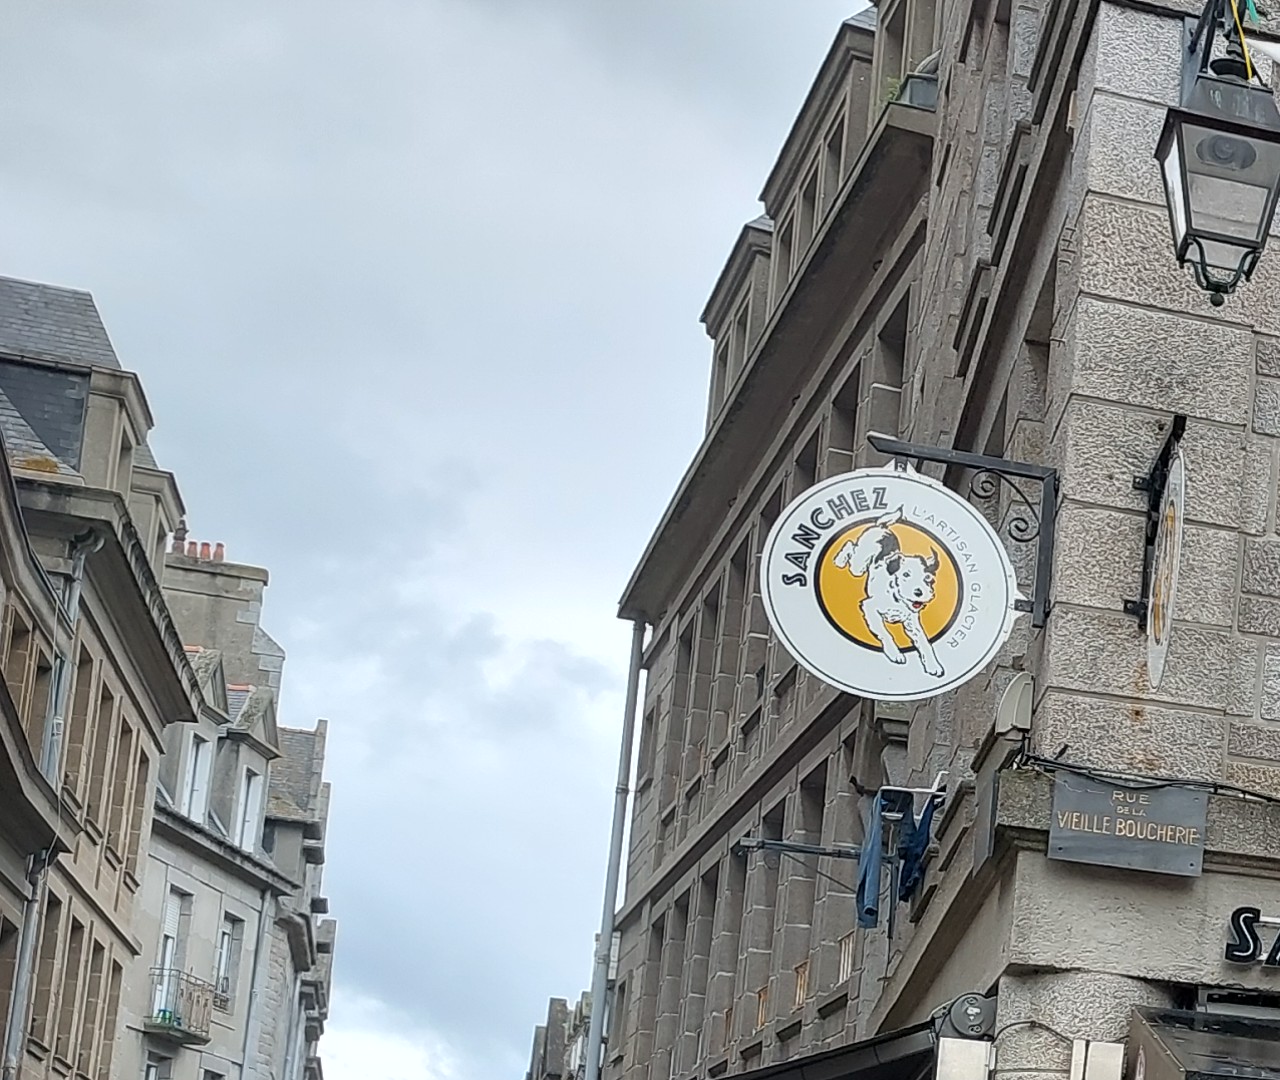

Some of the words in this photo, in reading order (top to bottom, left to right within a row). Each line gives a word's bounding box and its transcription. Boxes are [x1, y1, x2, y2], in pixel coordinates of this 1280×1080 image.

[782, 487, 888, 587] SANCHEZ
[912, 505, 978, 573] L'ARTISAN
[947, 582, 981, 650] GLACIER
[1112, 791, 1150, 805] RUE
[1116, 806, 1129, 815] DE
[1132, 808, 1147, 817] LA
[1057, 811, 1111, 835] VIEILLE
[1115, 818, 1200, 847] BOUCHERIE
